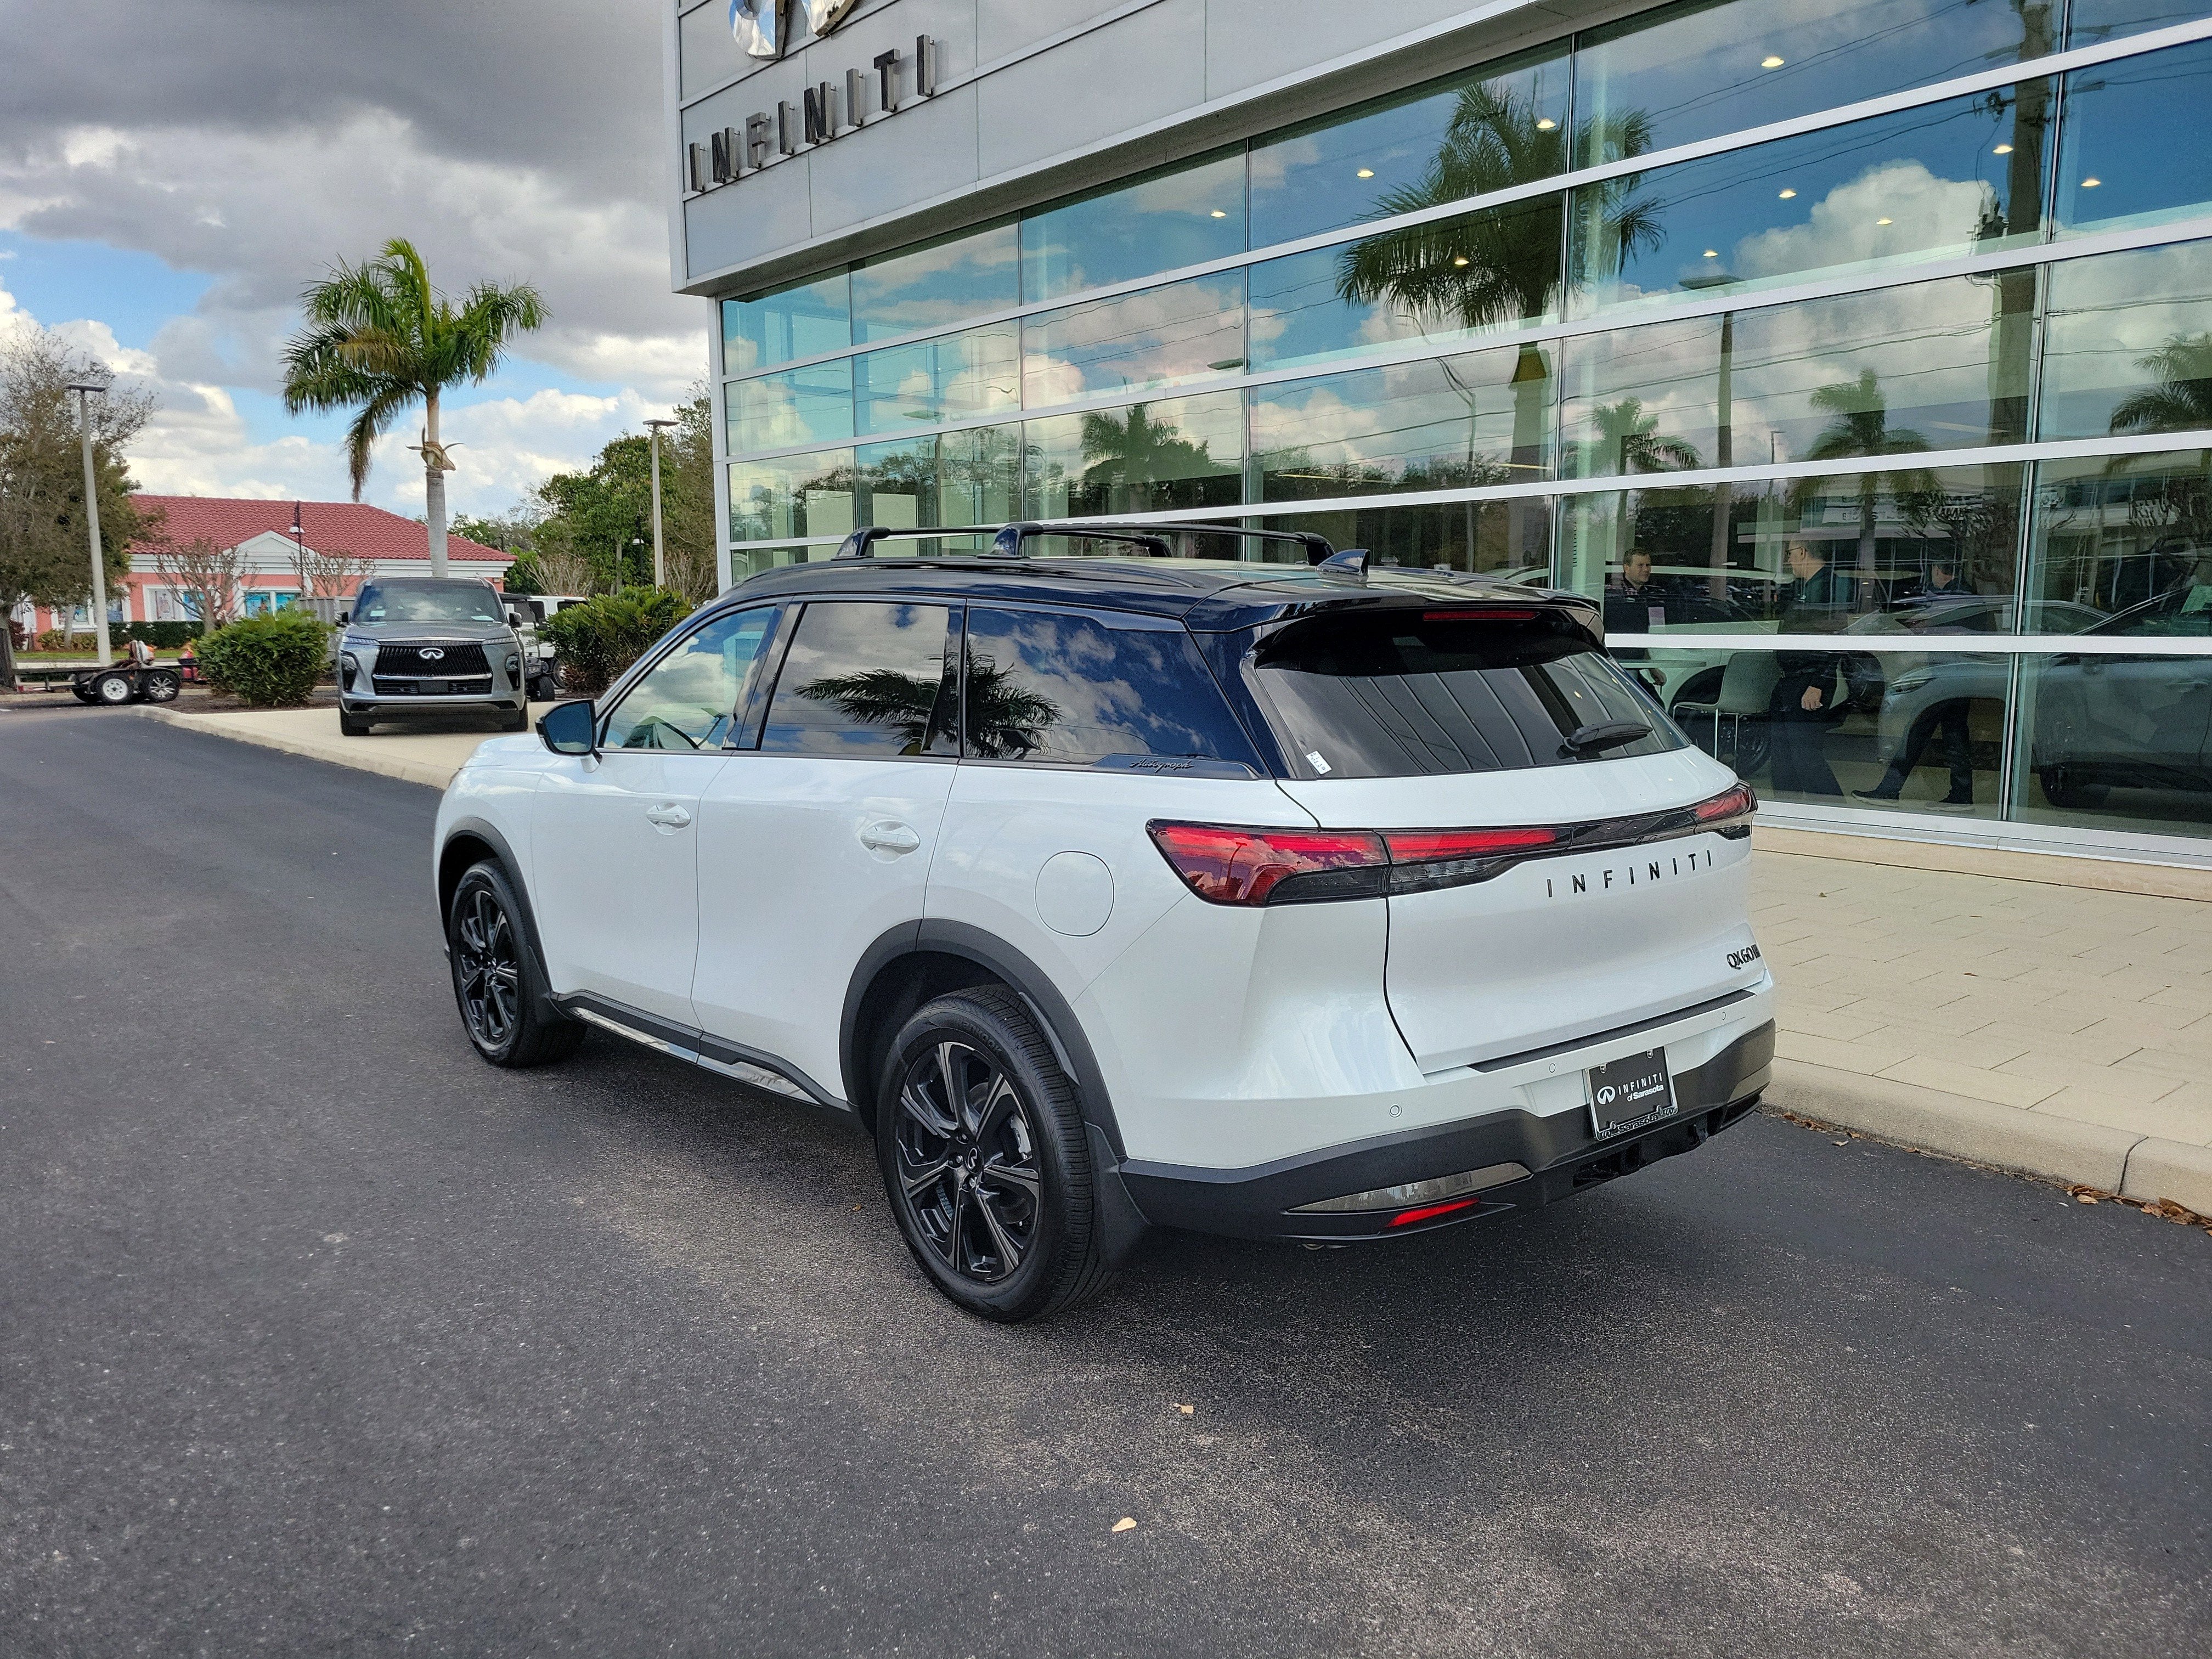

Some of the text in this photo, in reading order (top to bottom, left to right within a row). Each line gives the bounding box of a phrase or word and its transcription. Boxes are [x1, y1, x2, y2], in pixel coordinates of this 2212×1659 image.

[689, 33, 933, 191] INFINITI
[1129, 758, 1194, 774] Autograph
[1546, 849, 1712, 898] INFINITI
[1726, 946, 1755, 970] QX60
[1618, 1072, 1663, 1096] INFINITI
[1633, 1085, 1664, 1100] Sarasota
[1618, 1114, 1658, 1132] Sarasota
